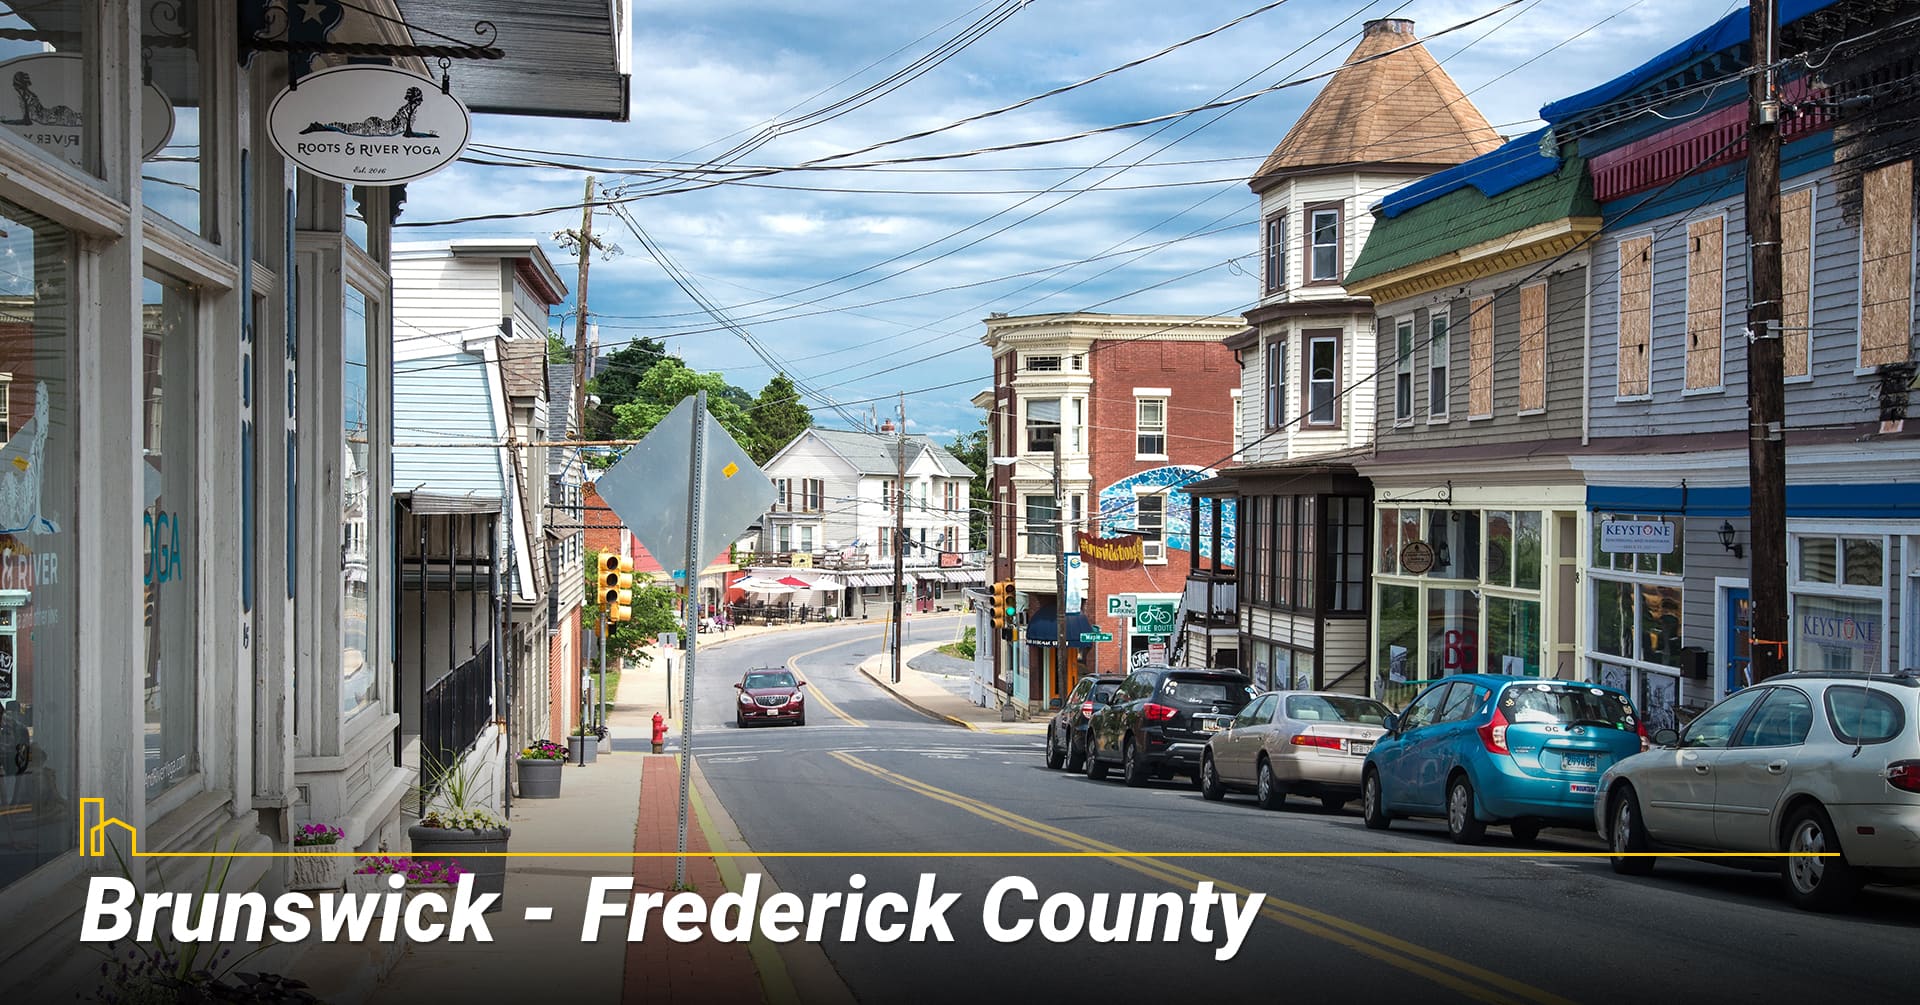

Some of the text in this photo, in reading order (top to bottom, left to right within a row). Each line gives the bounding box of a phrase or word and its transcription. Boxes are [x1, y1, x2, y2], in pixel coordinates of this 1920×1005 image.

[297, 143, 441, 157] ROOTS & RIVER YOGA
[353, 166, 366, 174] Est.
[1606, 525, 1670, 537] KEYSTONE
[144, 510, 182, 586] OGA
[18, 552, 59, 591] RIVER
[1109, 598, 1136, 614] PARKING
[1137, 624, 1173, 632] BIKE ROUTE
[1803, 615, 1874, 641] KEYSTONE
